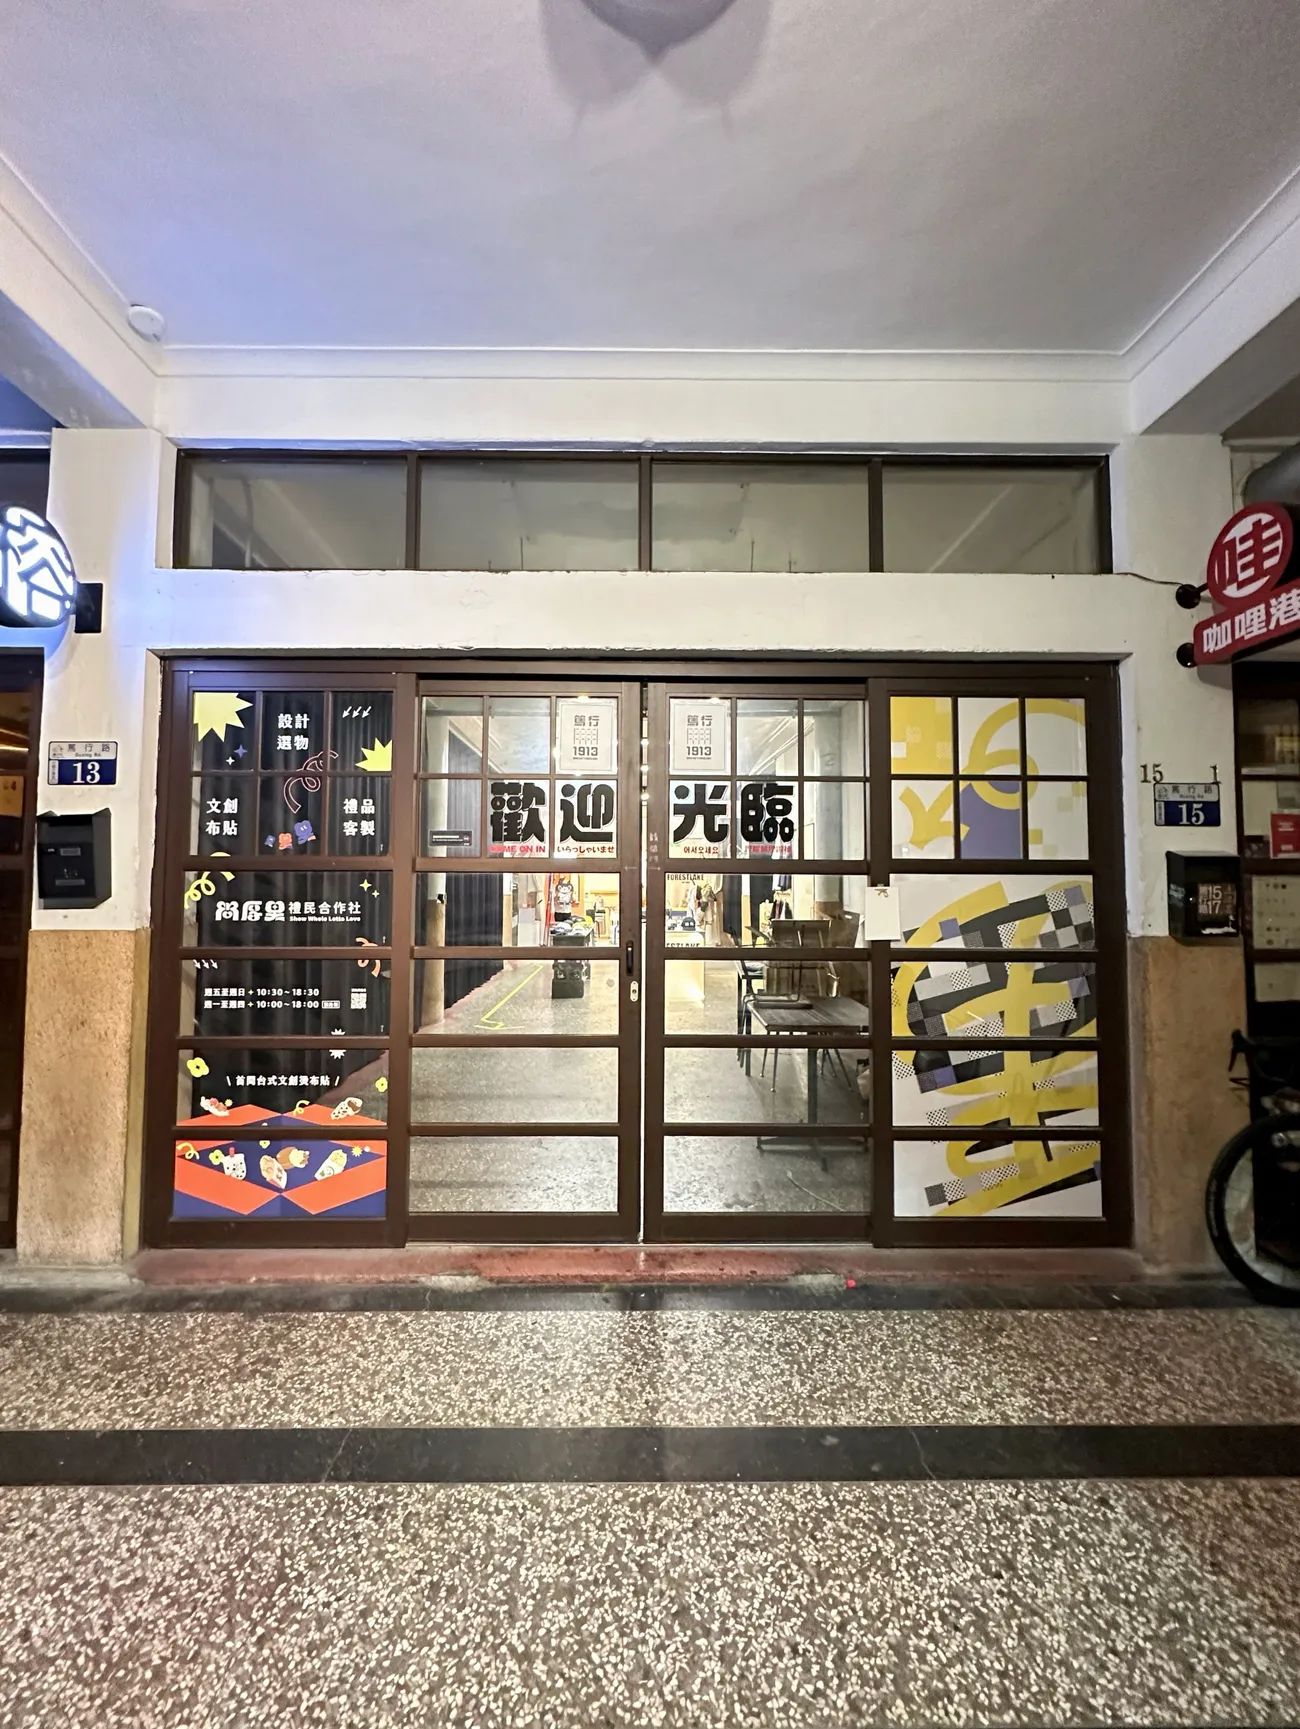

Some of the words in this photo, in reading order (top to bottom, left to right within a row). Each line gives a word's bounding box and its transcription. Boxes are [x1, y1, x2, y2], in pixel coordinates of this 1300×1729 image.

[1213, 514, 1282, 596] 哇
[277, 714, 310, 729] 設計
[277, 735, 310, 750] 選物
[573, 746, 598, 756] 1913
[686, 746, 712, 756] 1913
[73, 762, 100, 783] 13
[1140, 764, 1163, 783] 15
[1210, 764, 1221, 784] 1
[206, 798, 238, 814] 文創
[343, 799, 375, 814] 禮品
[490, 782, 615, 843] 歡迎
[673, 783, 795, 843] 光臨
[1178, 803, 1204, 825] 15
[206, 820, 238, 835] 布貼
[343, 821, 375, 836] 客製
[536, 845, 546, 853] IN
[557, 845, 614, 853] いらっしゃいませ
[667, 873, 704, 881] FORESTLAKE
[1208, 885, 1222, 900] 15
[288, 902, 361, 915] 禮民合作社
[1207, 900, 1222, 914] 17
